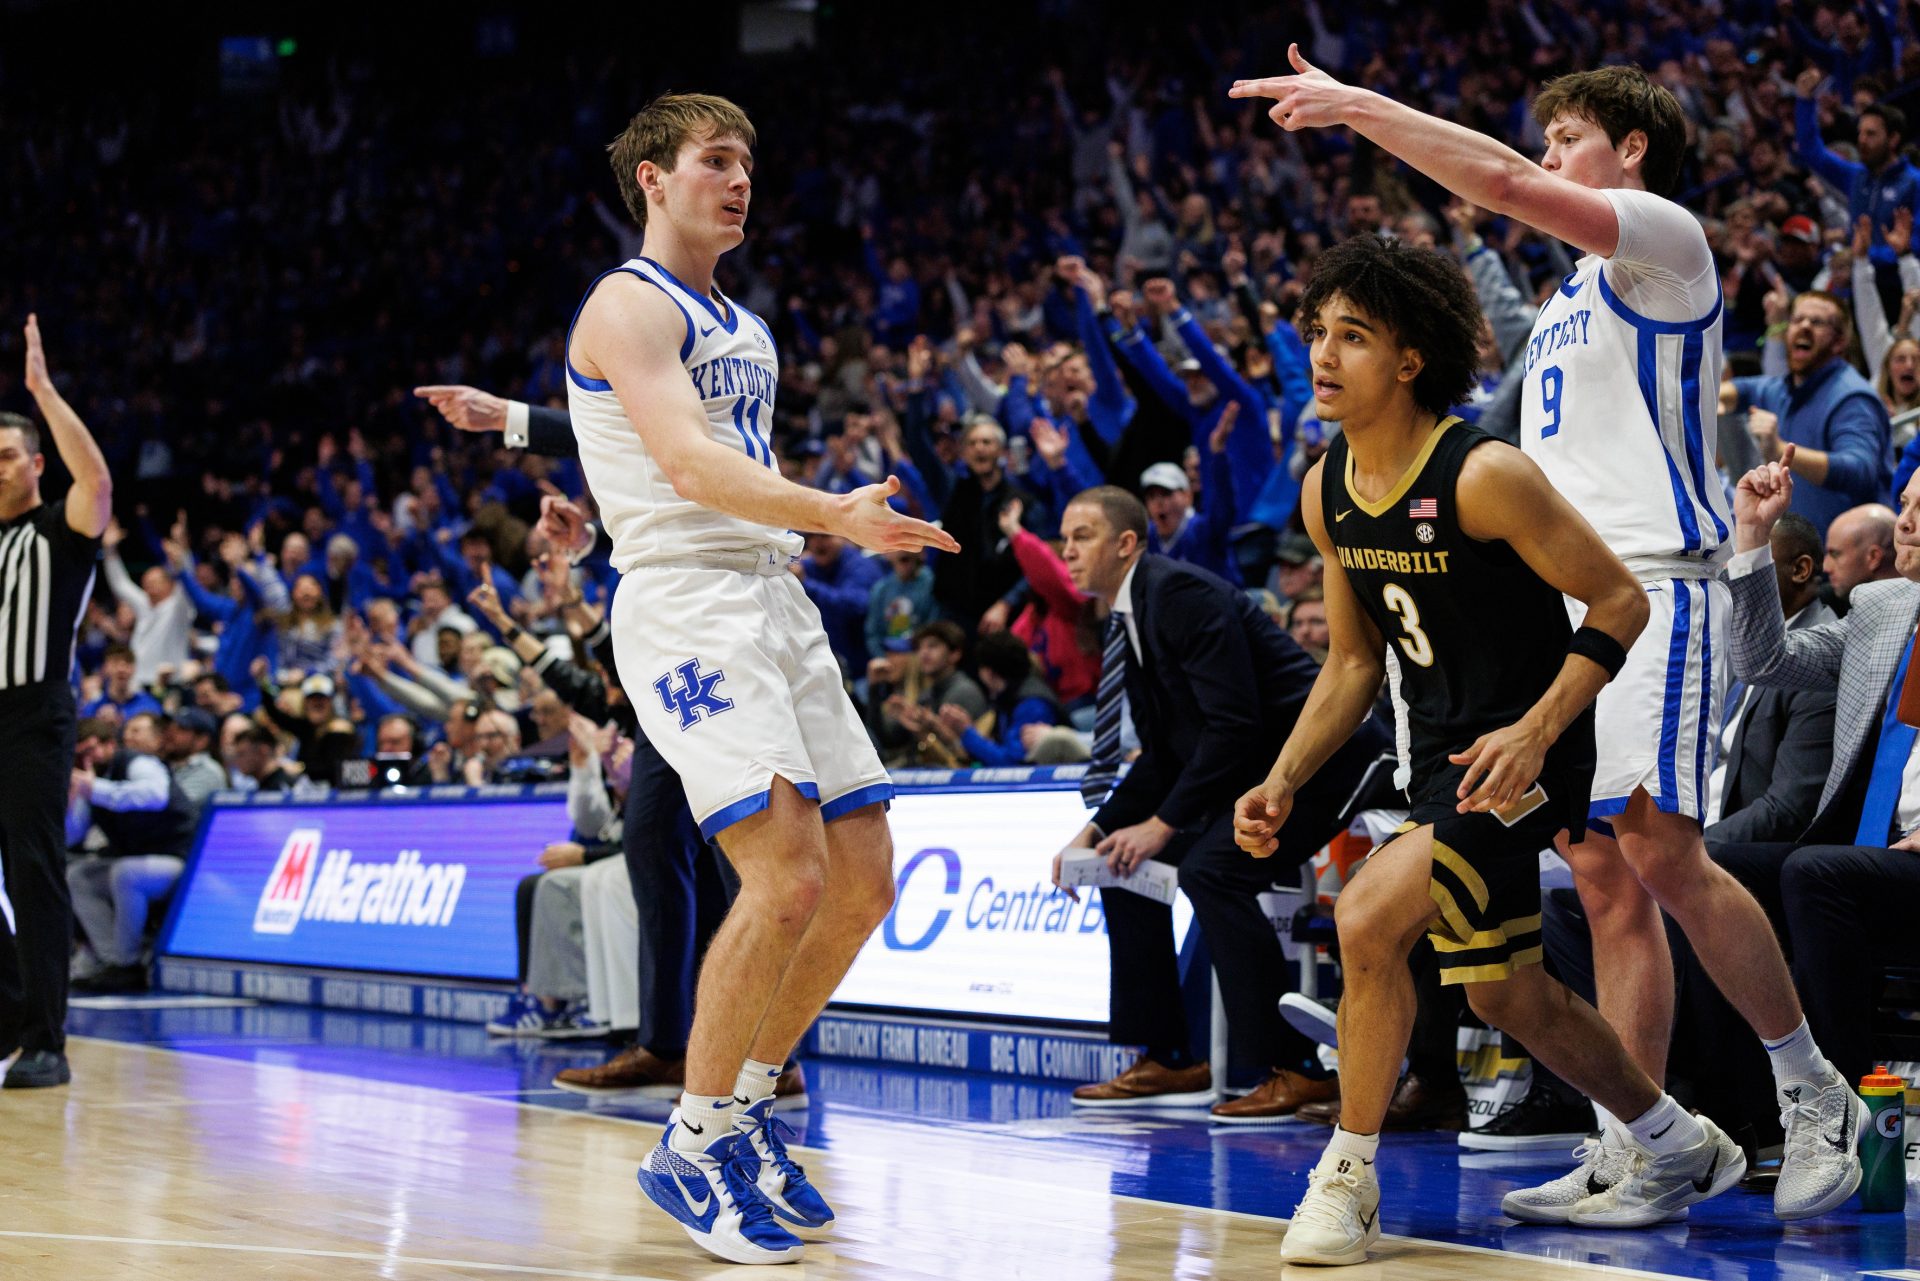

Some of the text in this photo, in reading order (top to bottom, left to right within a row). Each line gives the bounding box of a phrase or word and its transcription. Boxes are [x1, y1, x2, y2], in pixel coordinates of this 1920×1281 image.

[691, 357, 777, 408] KENTUCK
[1541, 364, 1563, 440] 9
[731, 394, 771, 469] 11
[1336, 545, 1449, 573] VANDERBILT
[1417, 524, 1433, 542] SEC
[1382, 582, 1434, 667] 3
[303, 848, 467, 927] Marathon
[965, 876, 1076, 931] Central
[1078, 884, 1109, 932] B
[818, 1020, 968, 1069] KENTUCKY FARM BUREAU
[990, 1034, 1014, 1073] BIG
[1016, 1037, 1038, 1075] ON
